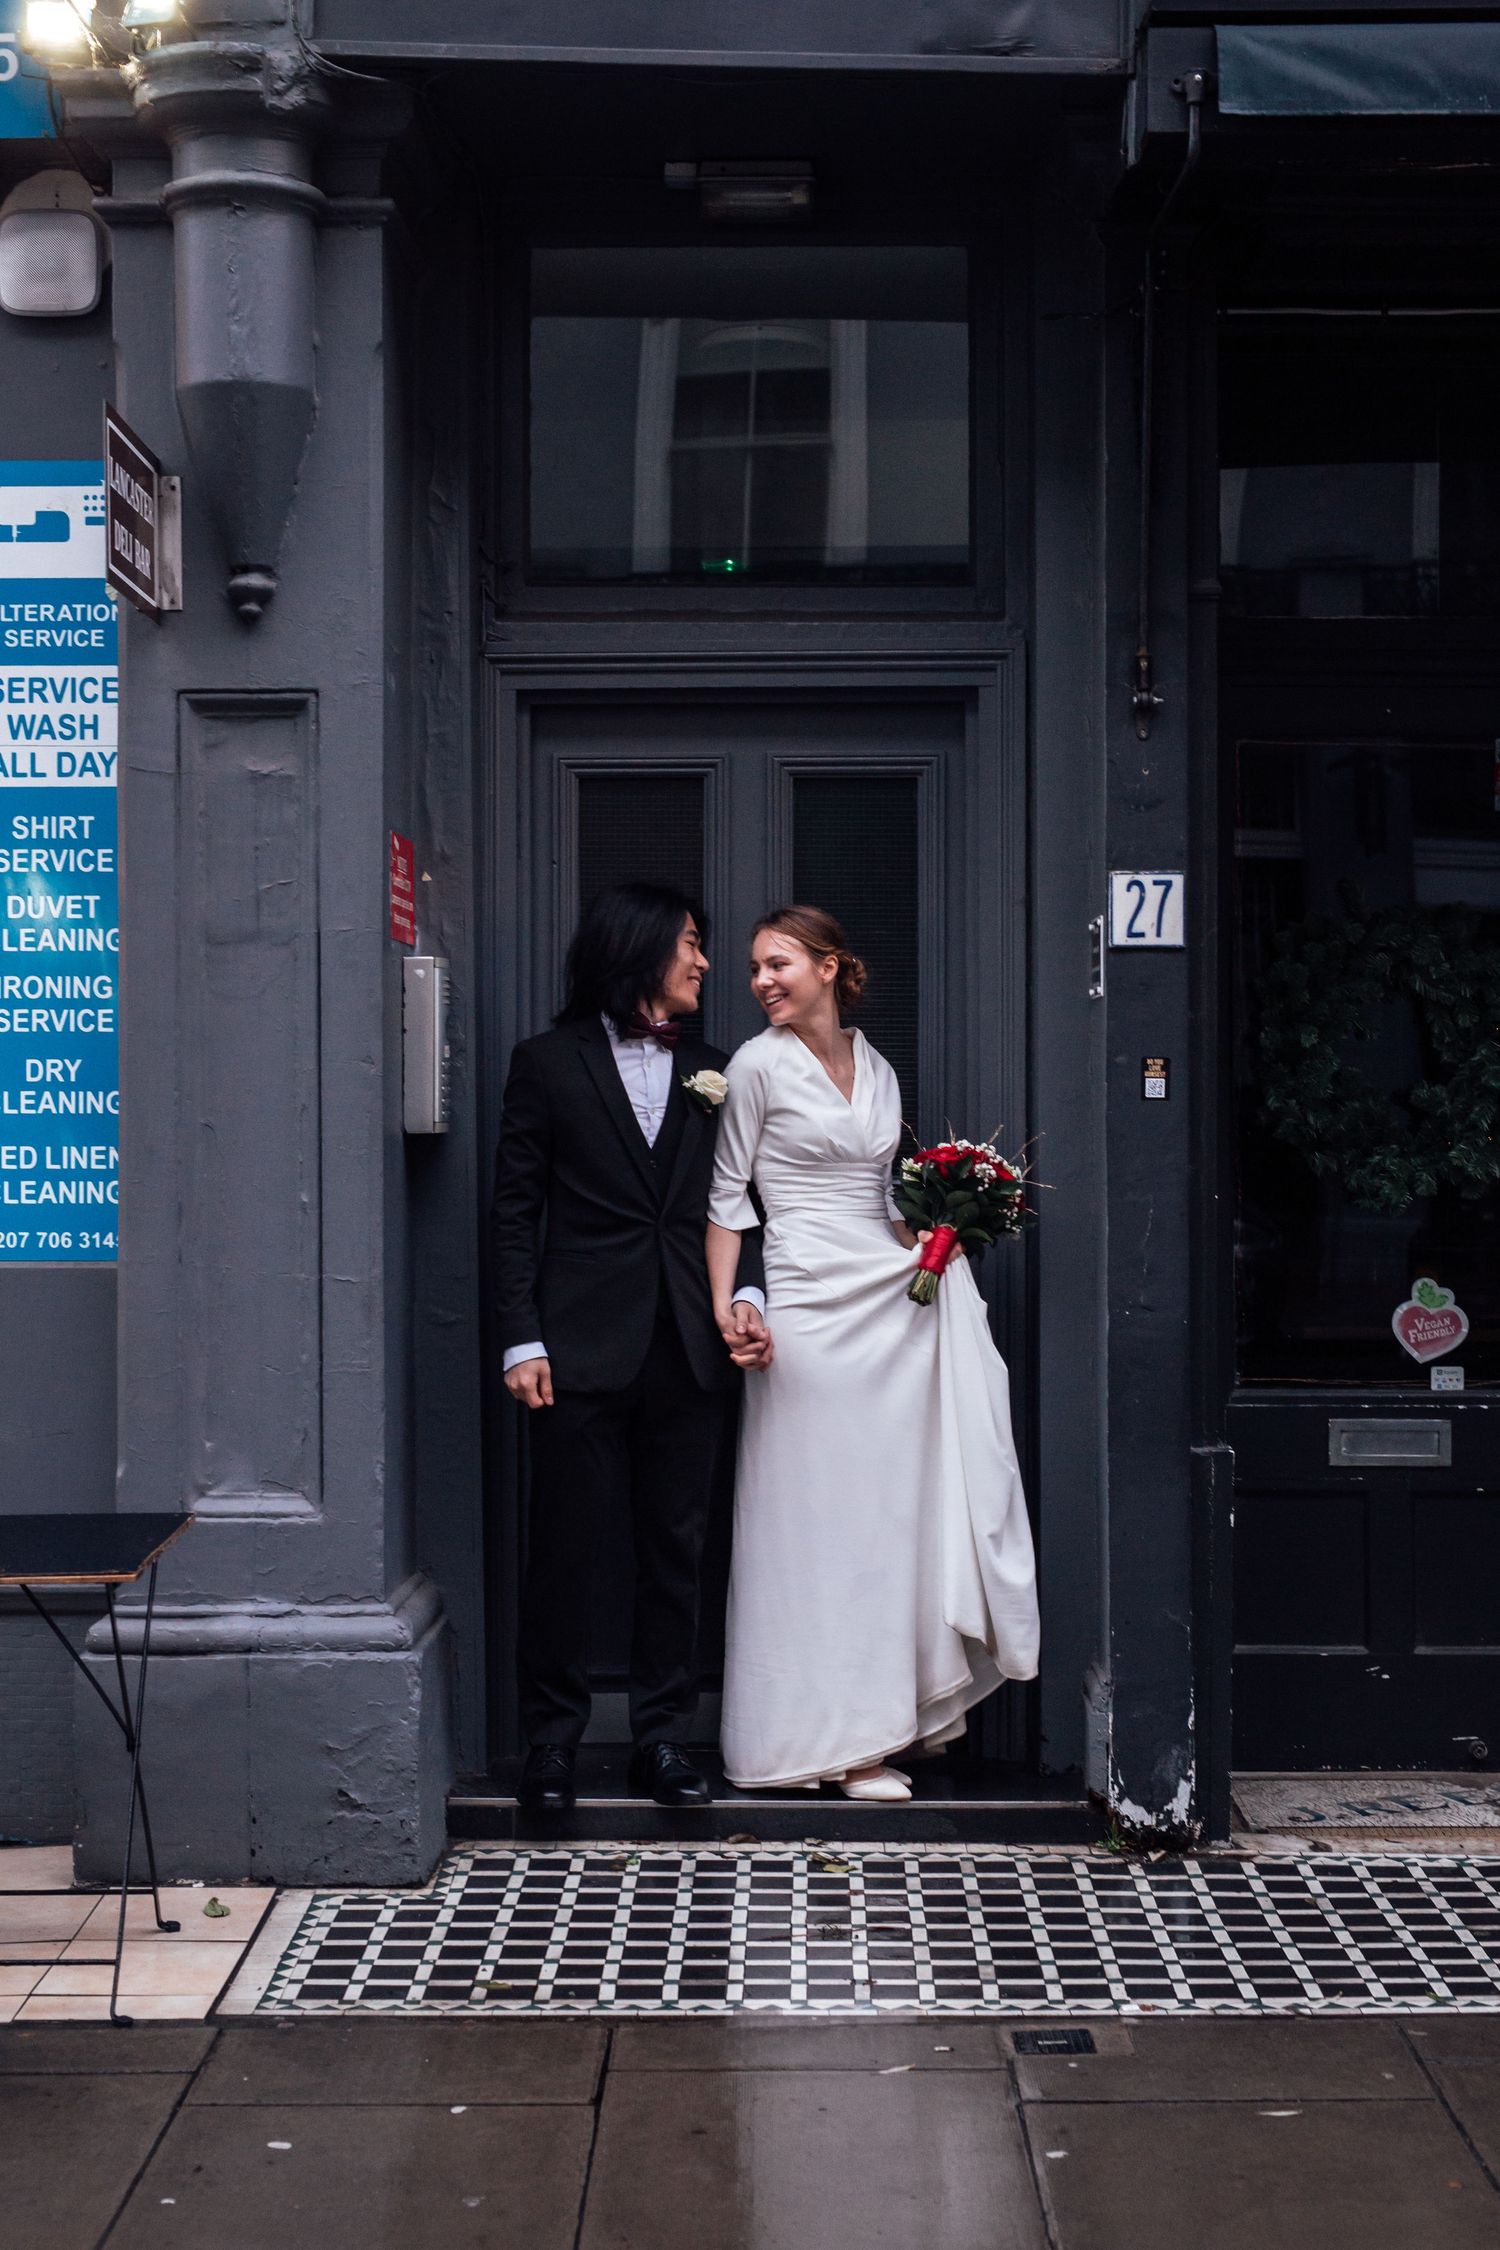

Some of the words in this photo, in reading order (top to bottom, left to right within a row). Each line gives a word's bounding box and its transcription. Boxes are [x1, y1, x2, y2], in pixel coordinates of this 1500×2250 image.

[109, 455, 155, 528] LANCASTER
[114, 518, 133, 564] DELI
[134, 538, 152, 580] BAR
[4, 629, 105, 648] SERVICE
[0, 676, 118, 704] ERVICE
[7, 713, 99, 741] WASH
[57, 751, 118, 778] DAY
[12, 815, 95, 840] SHIRT
[0, 848, 114, 873] SERVICE
[7, 895, 100, 919] DUVET
[1126, 879, 1173, 938] 27
[0, 975, 113, 999] RONING
[0, 1008, 114, 1033] SERVICE
[25, 1059, 82, 1082] DRY
[0, 1090, 119, 1115] LEANING
[0, 1181, 119, 1204] LEANING
[36, 1231, 73, 1248] 706
[79, 1231, 119, 1248] 314
[1408, 1325, 1457, 1344] FRIENDLY
[1414, 1317, 1451, 1331] VEGAN
